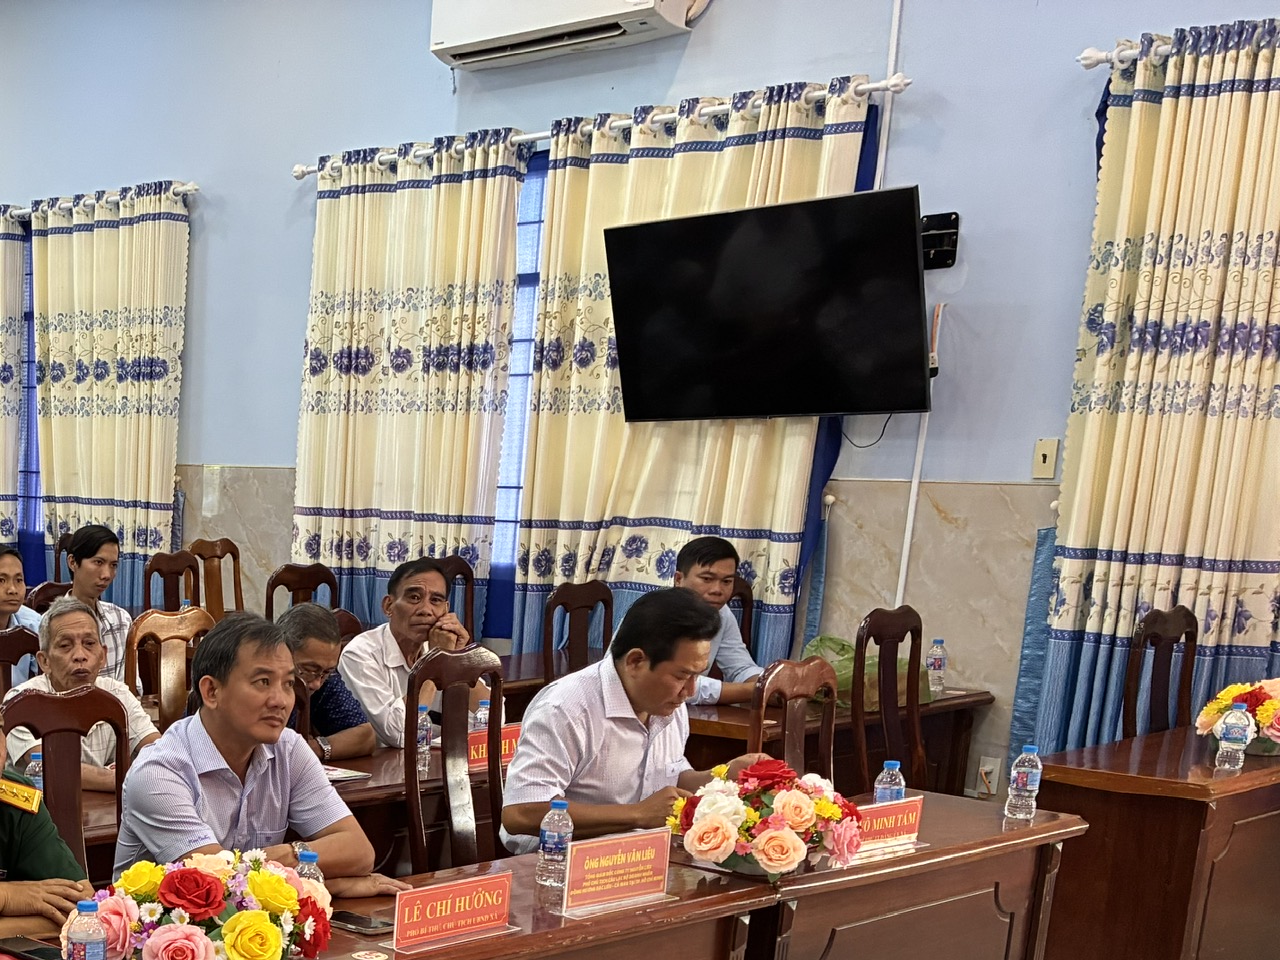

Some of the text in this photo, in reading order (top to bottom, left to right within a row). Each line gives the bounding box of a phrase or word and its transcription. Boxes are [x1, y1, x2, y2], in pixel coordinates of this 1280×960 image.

[872, 816, 896, 831] MINH
[897, 810, 916, 826] TÁM
[584, 846, 655, 870] ÔNG NGUYỄN VĂN LIÊU
[404, 888, 502, 923] LÊ CHÍ HƯỞNG
